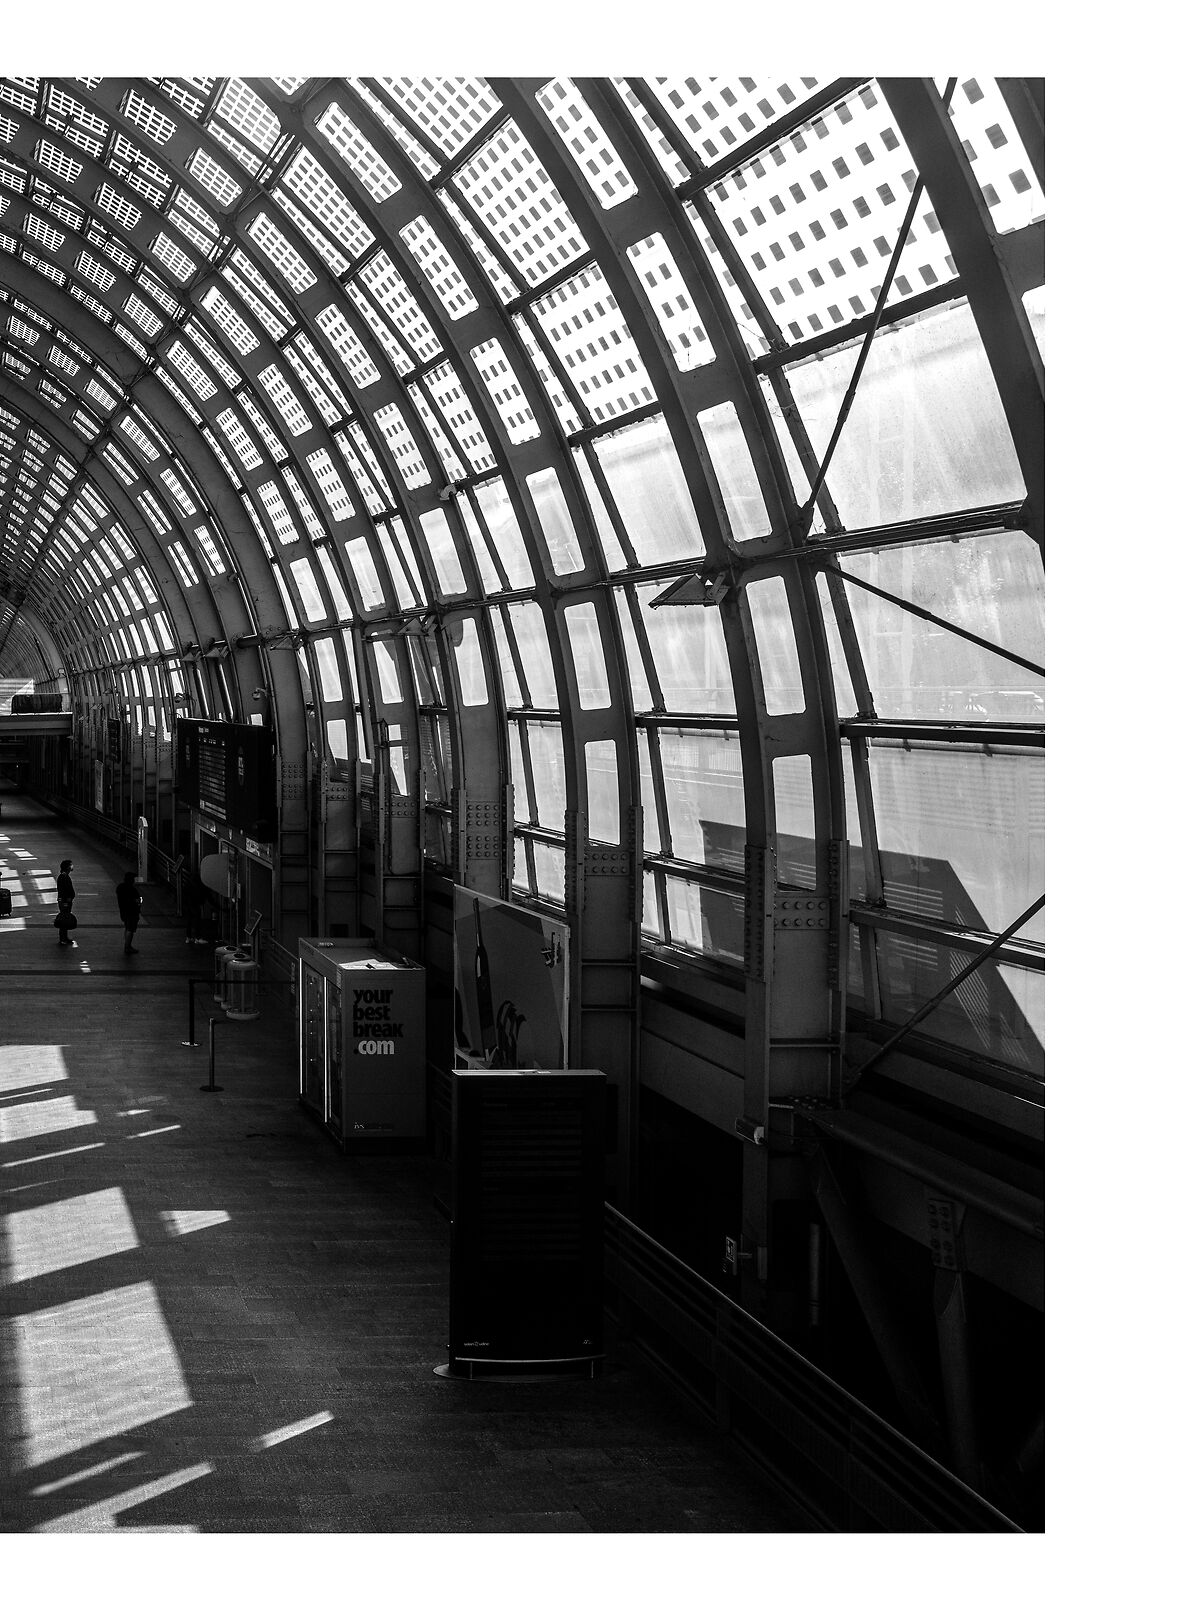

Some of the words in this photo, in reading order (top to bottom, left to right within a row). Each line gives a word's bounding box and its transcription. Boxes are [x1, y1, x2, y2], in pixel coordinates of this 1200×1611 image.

[353, 989, 393, 1005] your
[353, 1005, 390, 1020] best
[353, 1021, 404, 1037] break
